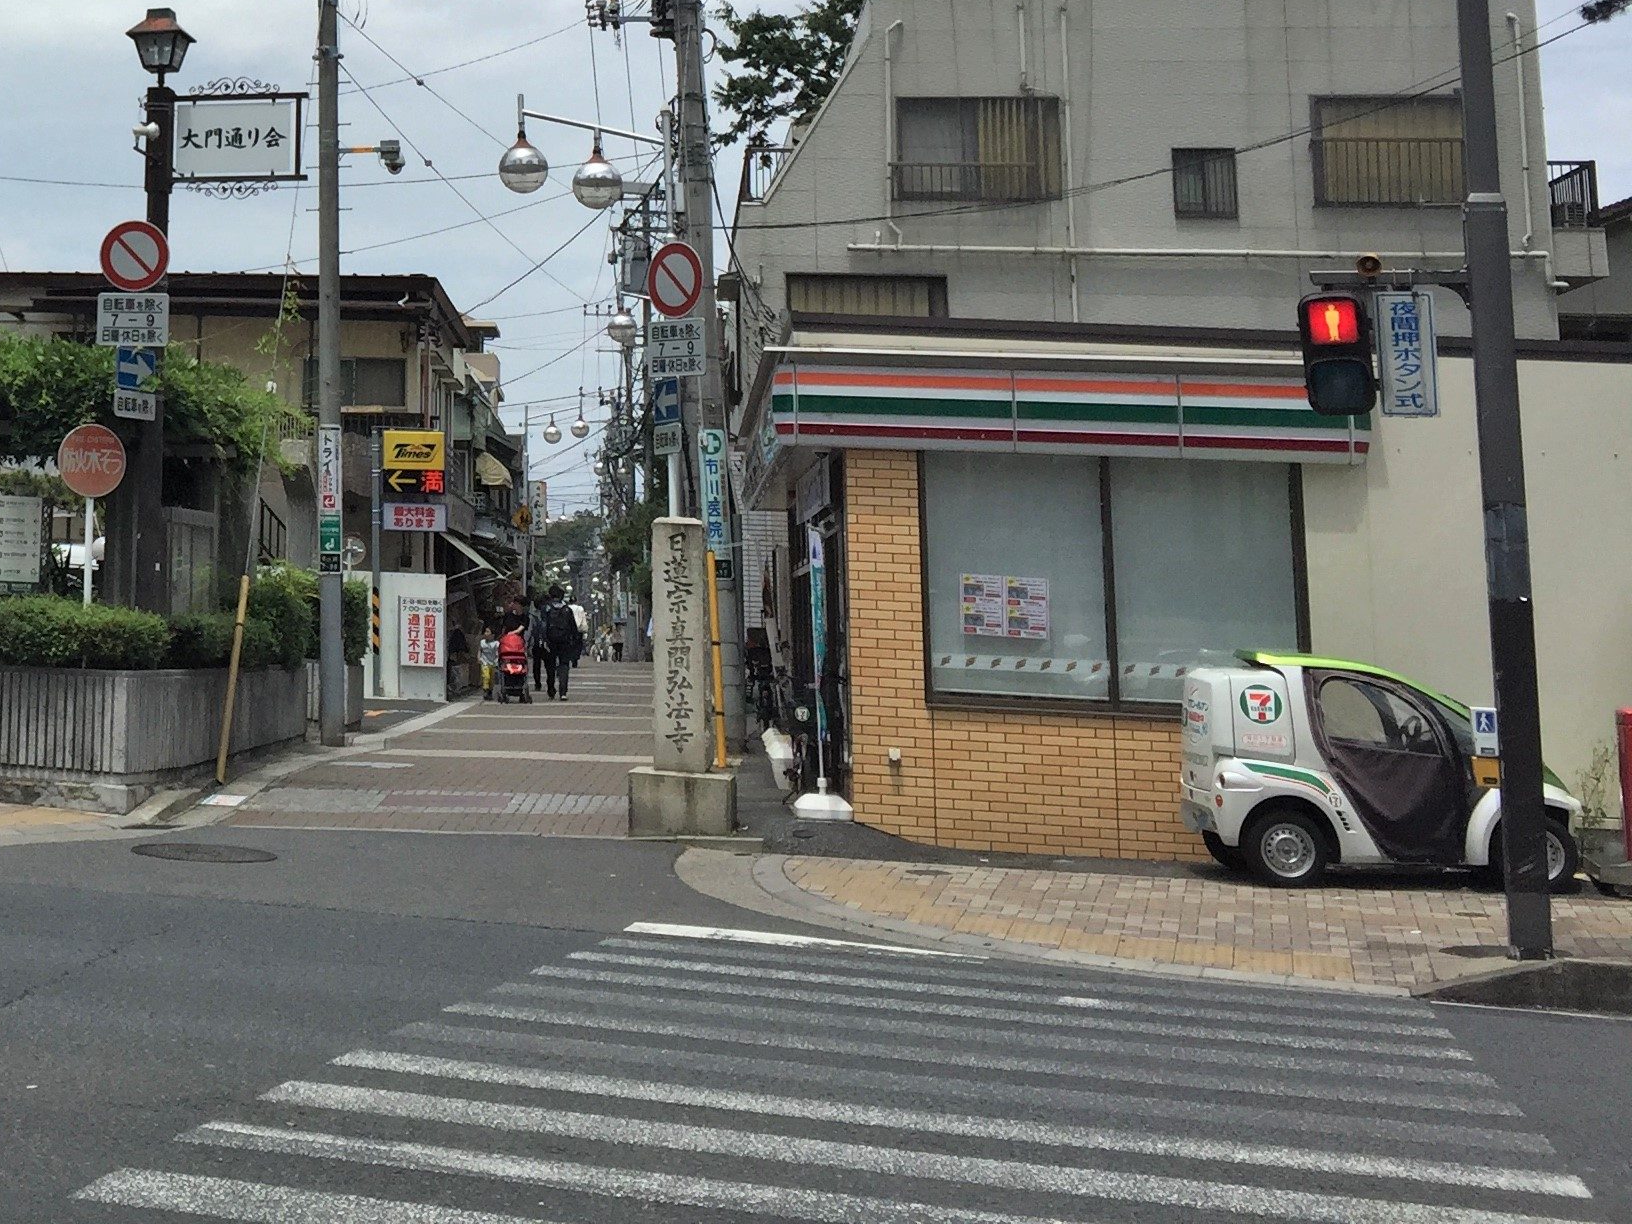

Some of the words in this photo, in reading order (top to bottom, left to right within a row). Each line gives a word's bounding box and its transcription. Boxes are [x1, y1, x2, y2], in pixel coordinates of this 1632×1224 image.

[179, 126, 287, 151] 大門通り会
[103, 298, 163, 312] 自転車を除く
[651, 323, 701, 340] 自転車を除く
[1389, 301, 1424, 409] 夜間押ボタン式
[117, 396, 154, 415] 自転車を除く
[393, 443, 437, 459] Times
[420, 470, 444, 493] 満
[705, 458, 723, 539] 市川医院
[393, 506, 436, 518] 最大料金
[393, 517, 436, 529] あります
[408, 613, 421, 664] 通行不可
[424, 614, 436, 665] 前面道路
[663, 532, 695, 754] 日蓮宗真間弘法寺
[1249, 693, 1272, 722] 7
